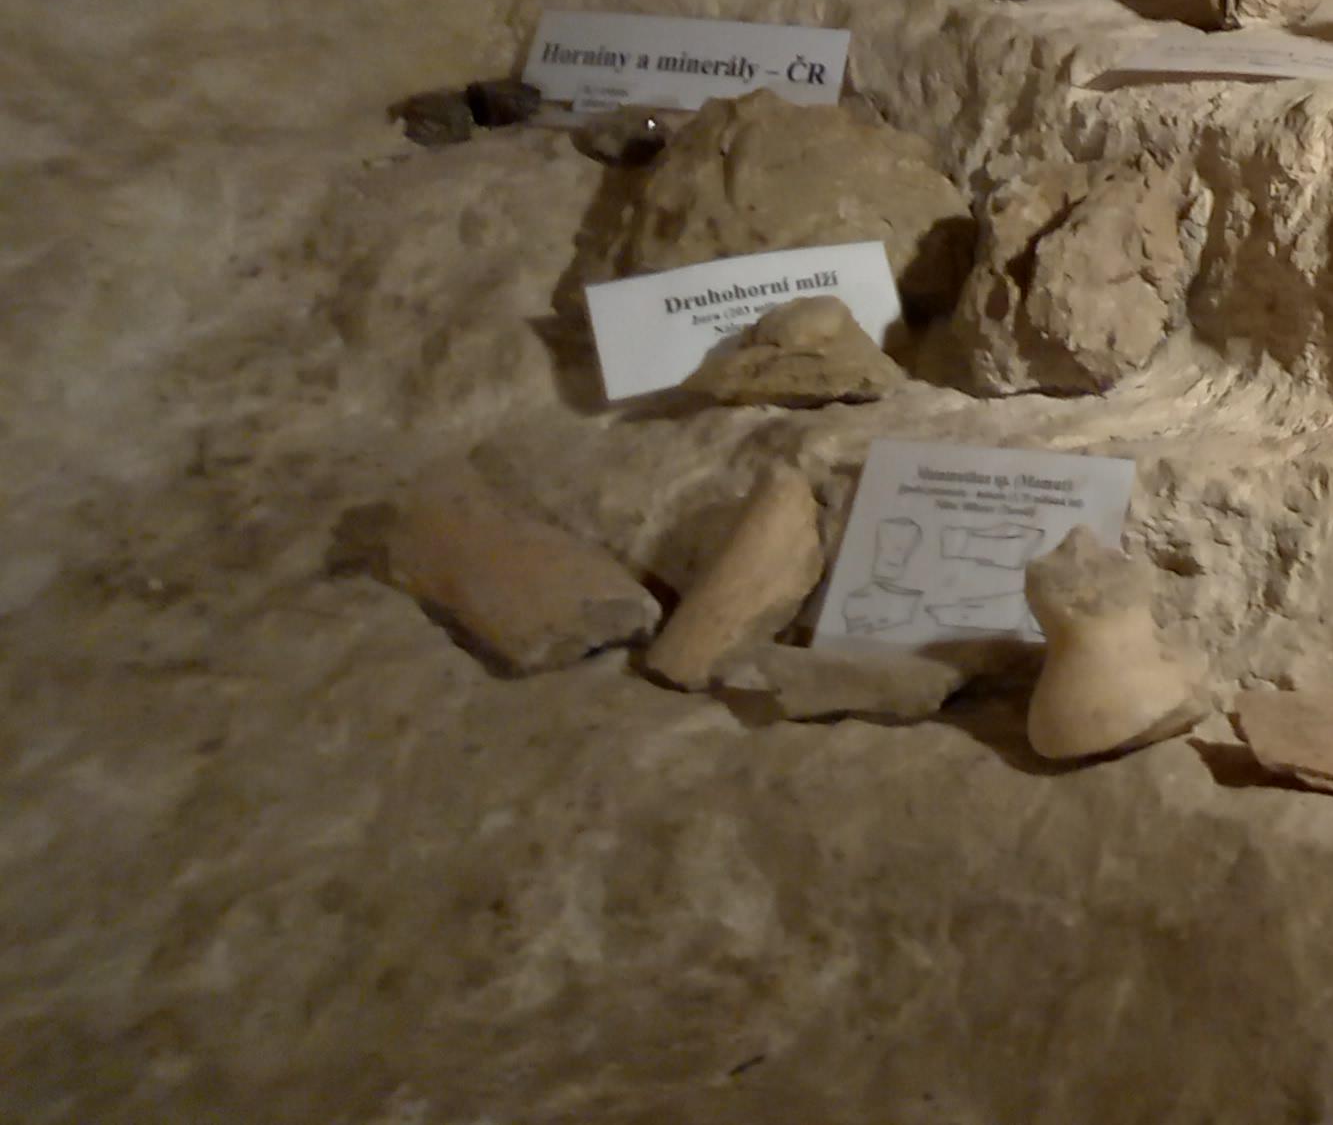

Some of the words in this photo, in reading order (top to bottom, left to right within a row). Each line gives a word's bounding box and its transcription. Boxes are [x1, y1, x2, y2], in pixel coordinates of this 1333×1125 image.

[541, 41, 630, 73] Horniny
[635, 53, 649, 70] a
[656, 50, 759, 83] minerály
[786, 54, 827, 86] ČR
[665, 276, 790, 315] Druhohorní
